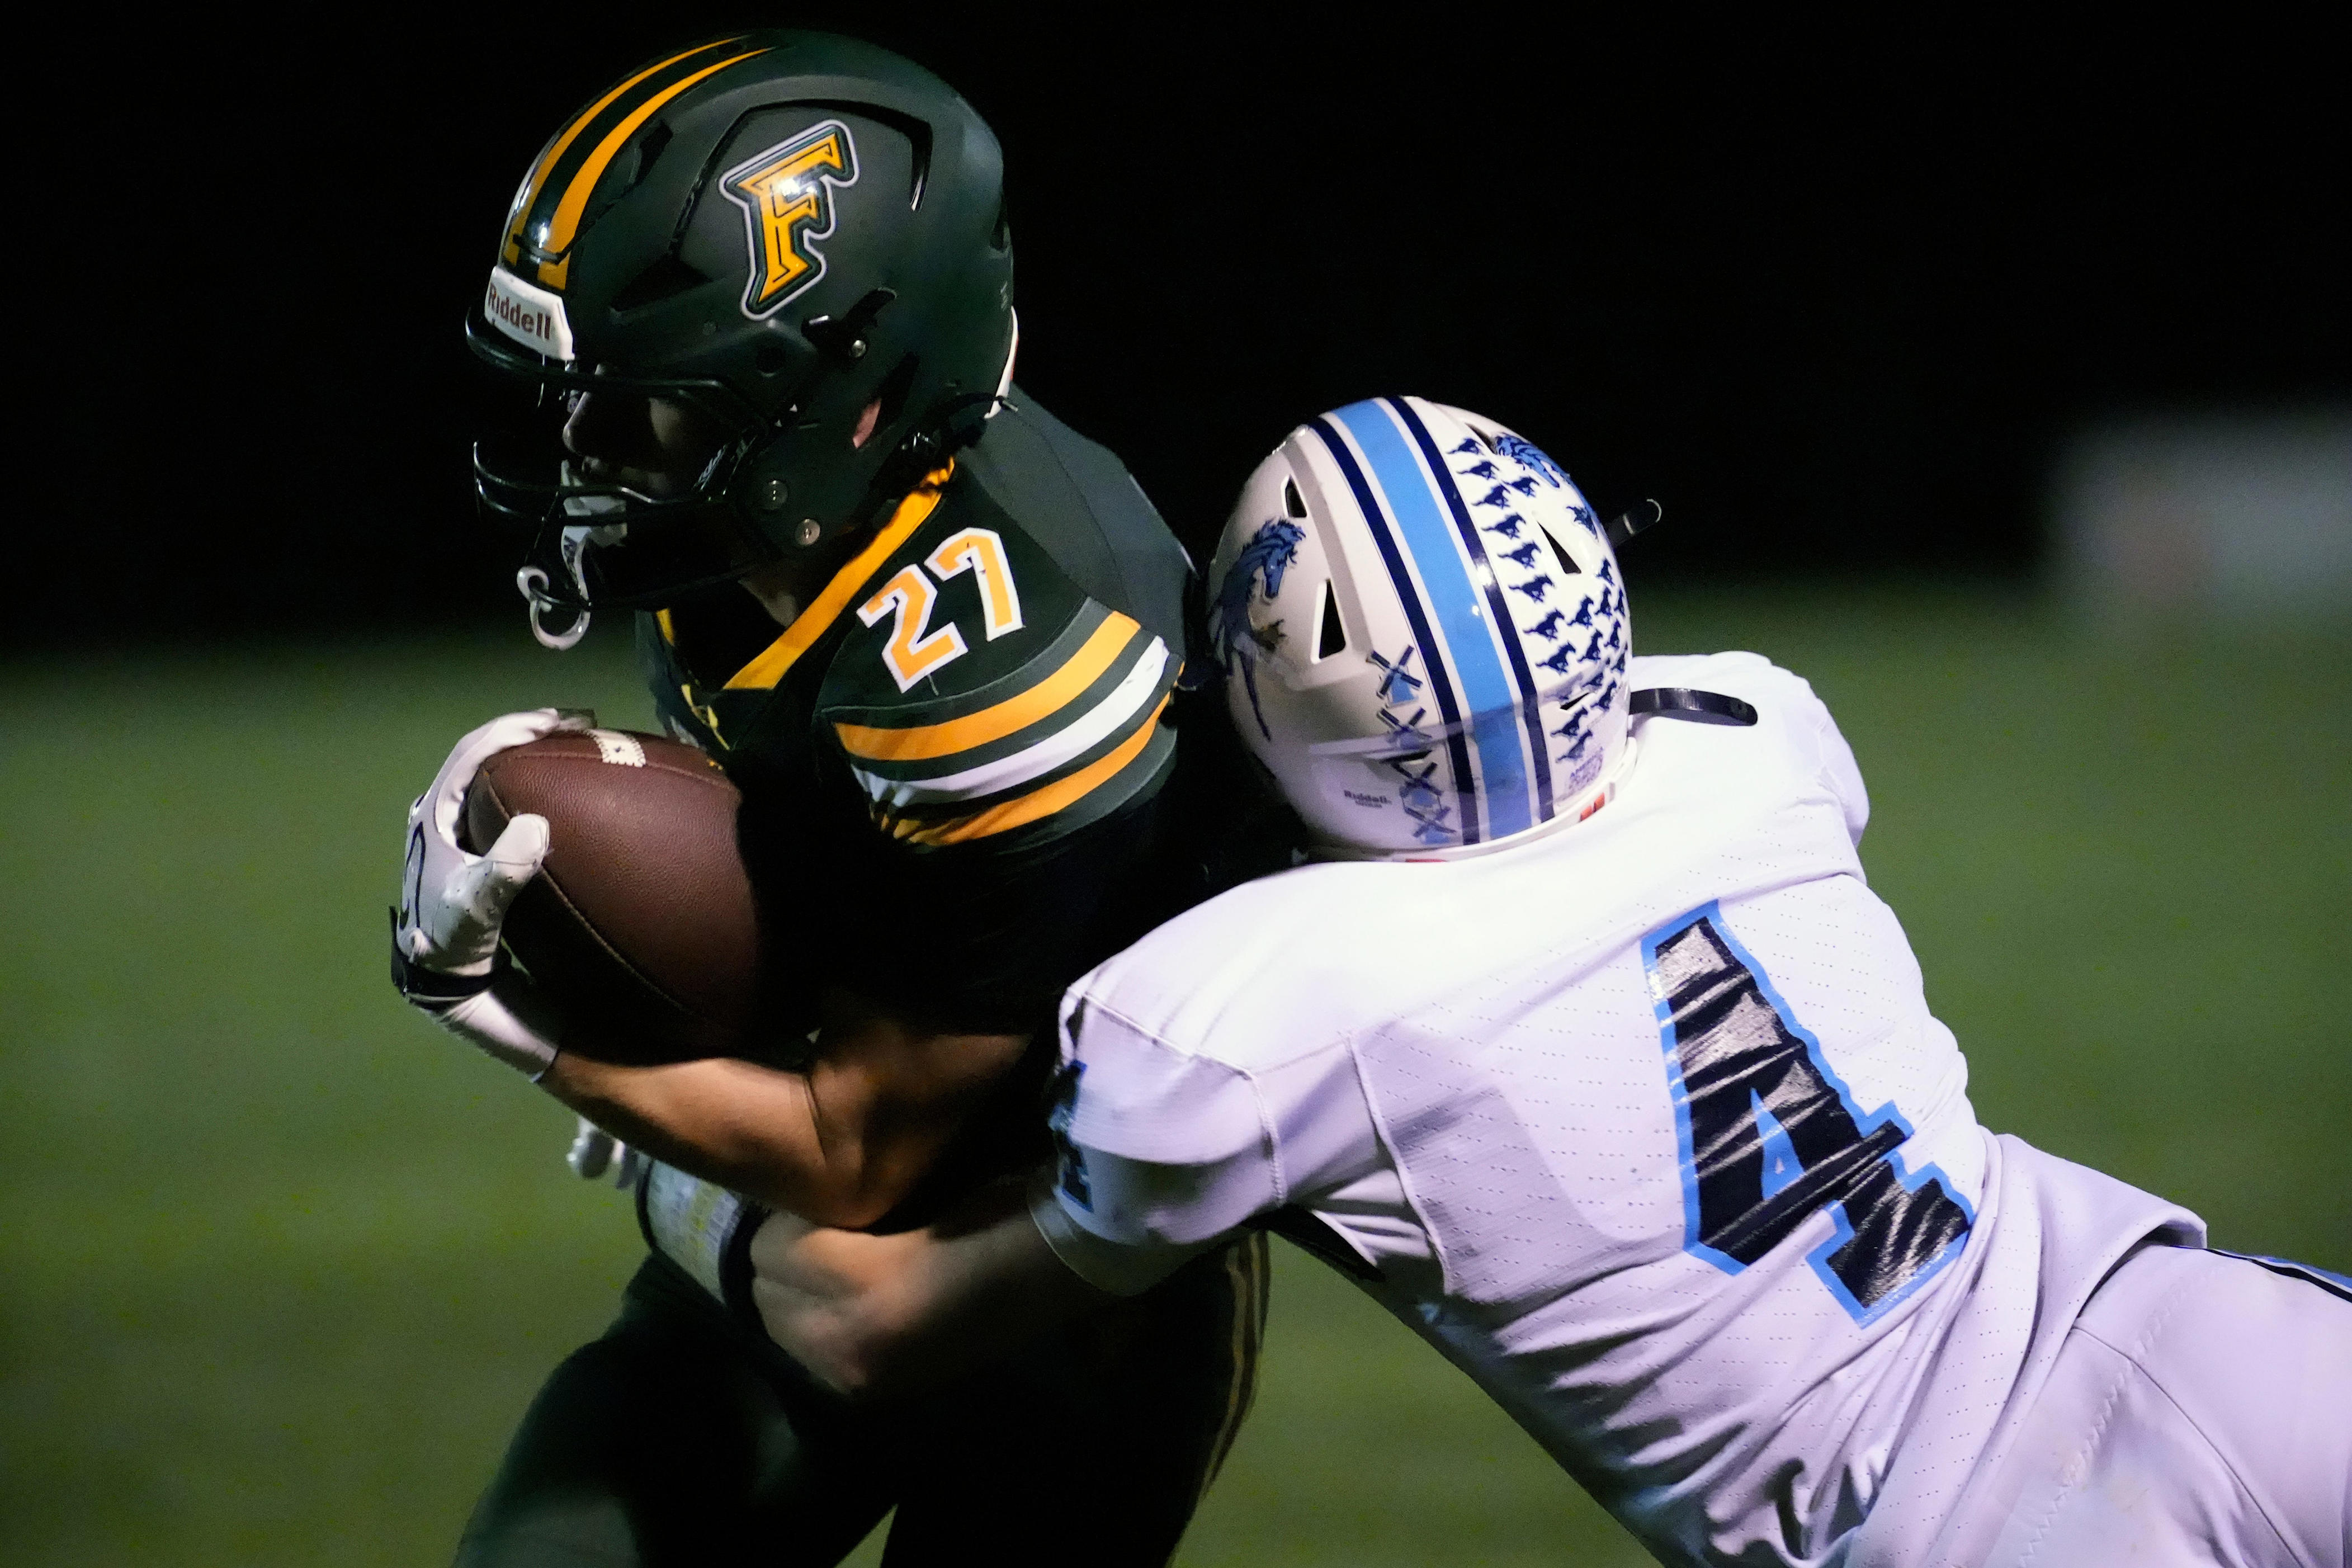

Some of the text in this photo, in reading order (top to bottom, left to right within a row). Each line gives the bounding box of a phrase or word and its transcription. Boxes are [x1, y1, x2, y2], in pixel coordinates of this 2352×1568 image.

[488, 282, 551, 340] Riddell
[719, 119, 859, 321] F
[856, 527, 1024, 693] 27
[1640, 898, 1977, 1330] 4
